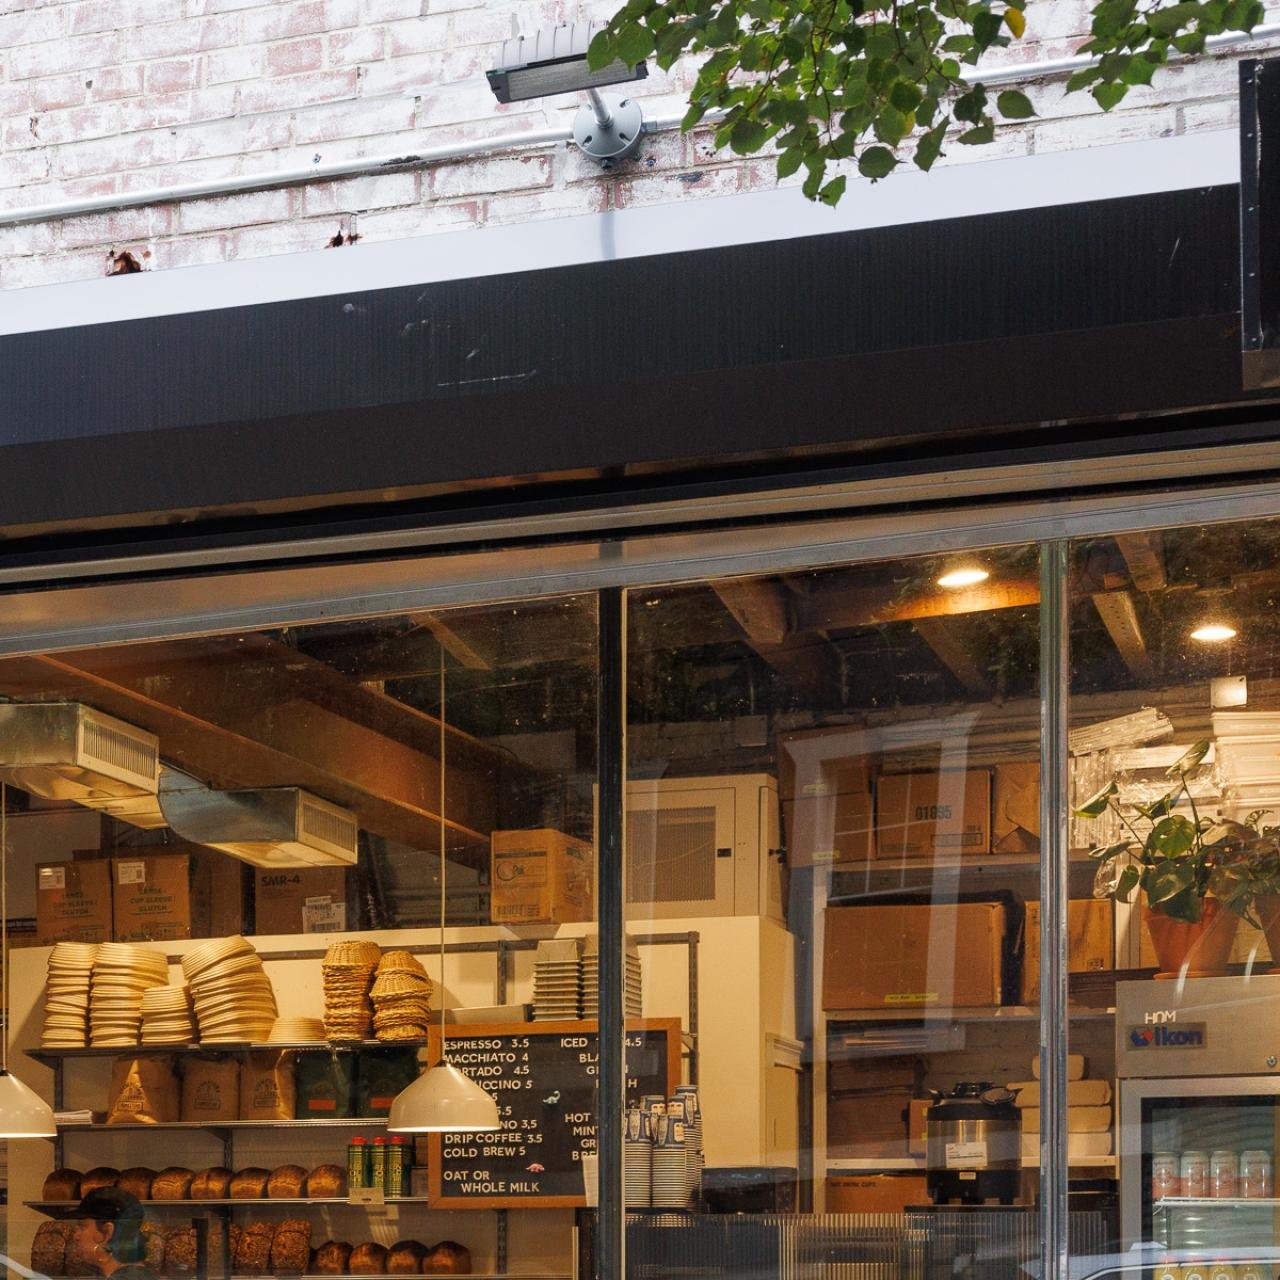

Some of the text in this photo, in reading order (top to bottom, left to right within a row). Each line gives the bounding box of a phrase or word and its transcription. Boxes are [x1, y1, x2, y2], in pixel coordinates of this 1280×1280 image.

[444, 1038, 530, 1050] ESPRESSO 3.5
[560, 1037, 589, 1048] ICED
[443, 1052, 529, 1064] MACCHIATO 4
[460, 1065, 530, 1077] RTADO 4.5
[525, 1080, 533, 1090] 5
[564, 1113, 591, 1123] HOT
[573, 1125, 599, 1136] MIN
[444, 1133, 543, 1144] DRIP COFFEE 3.5
[443, 1146, 527, 1159] COLD BREW 5
[443, 1170, 490, 1181] OAT OR
[460, 1181, 540, 1193] WHOLE MILK
